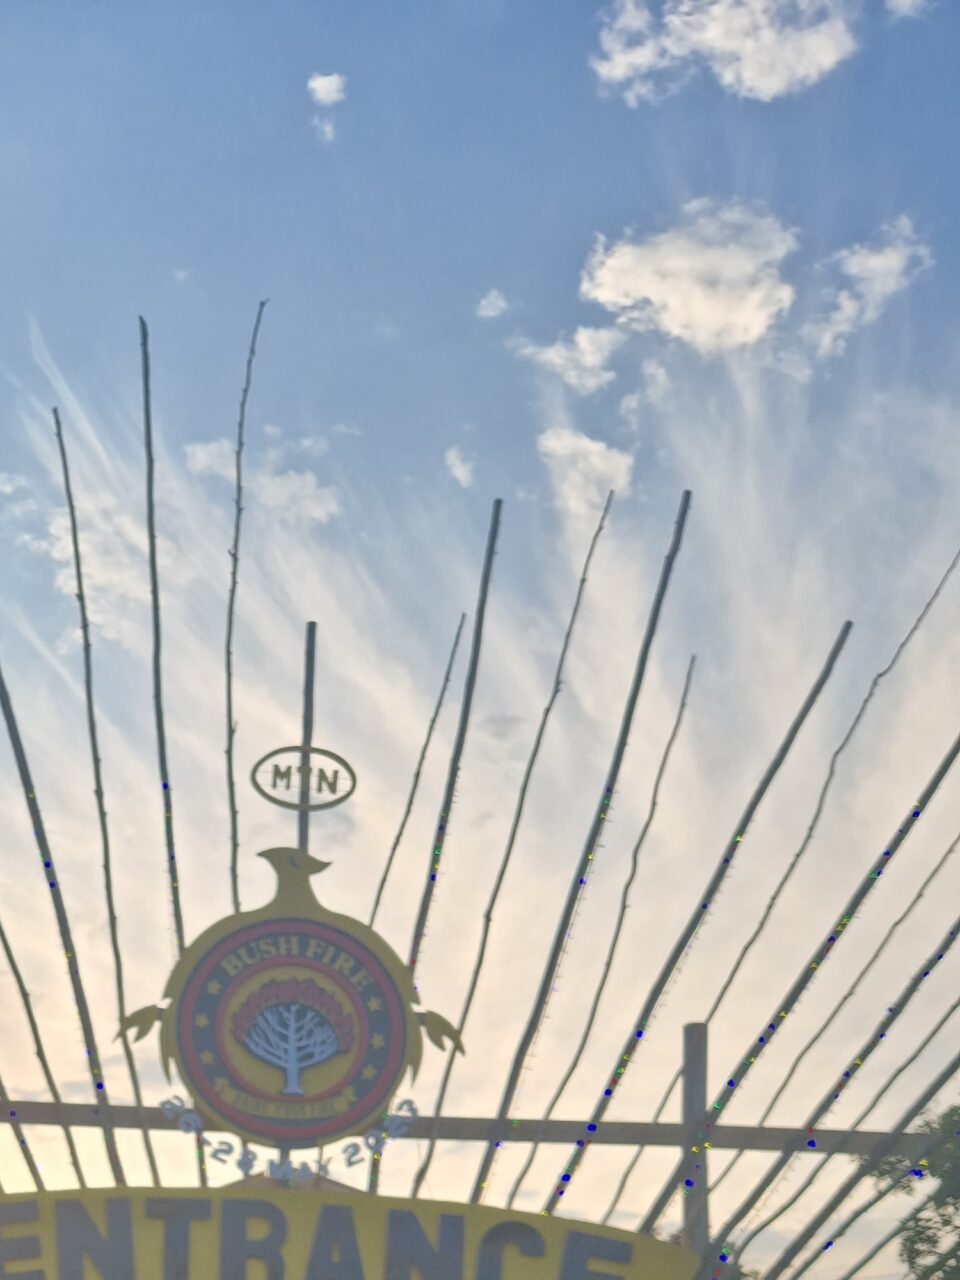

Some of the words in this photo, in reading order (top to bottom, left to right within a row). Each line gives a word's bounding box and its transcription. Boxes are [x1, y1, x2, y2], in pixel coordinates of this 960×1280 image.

[271, 764, 339, 794] MTN
[221, 935, 299, 977] BUSH
[304, 936, 373, 991] FIRE
